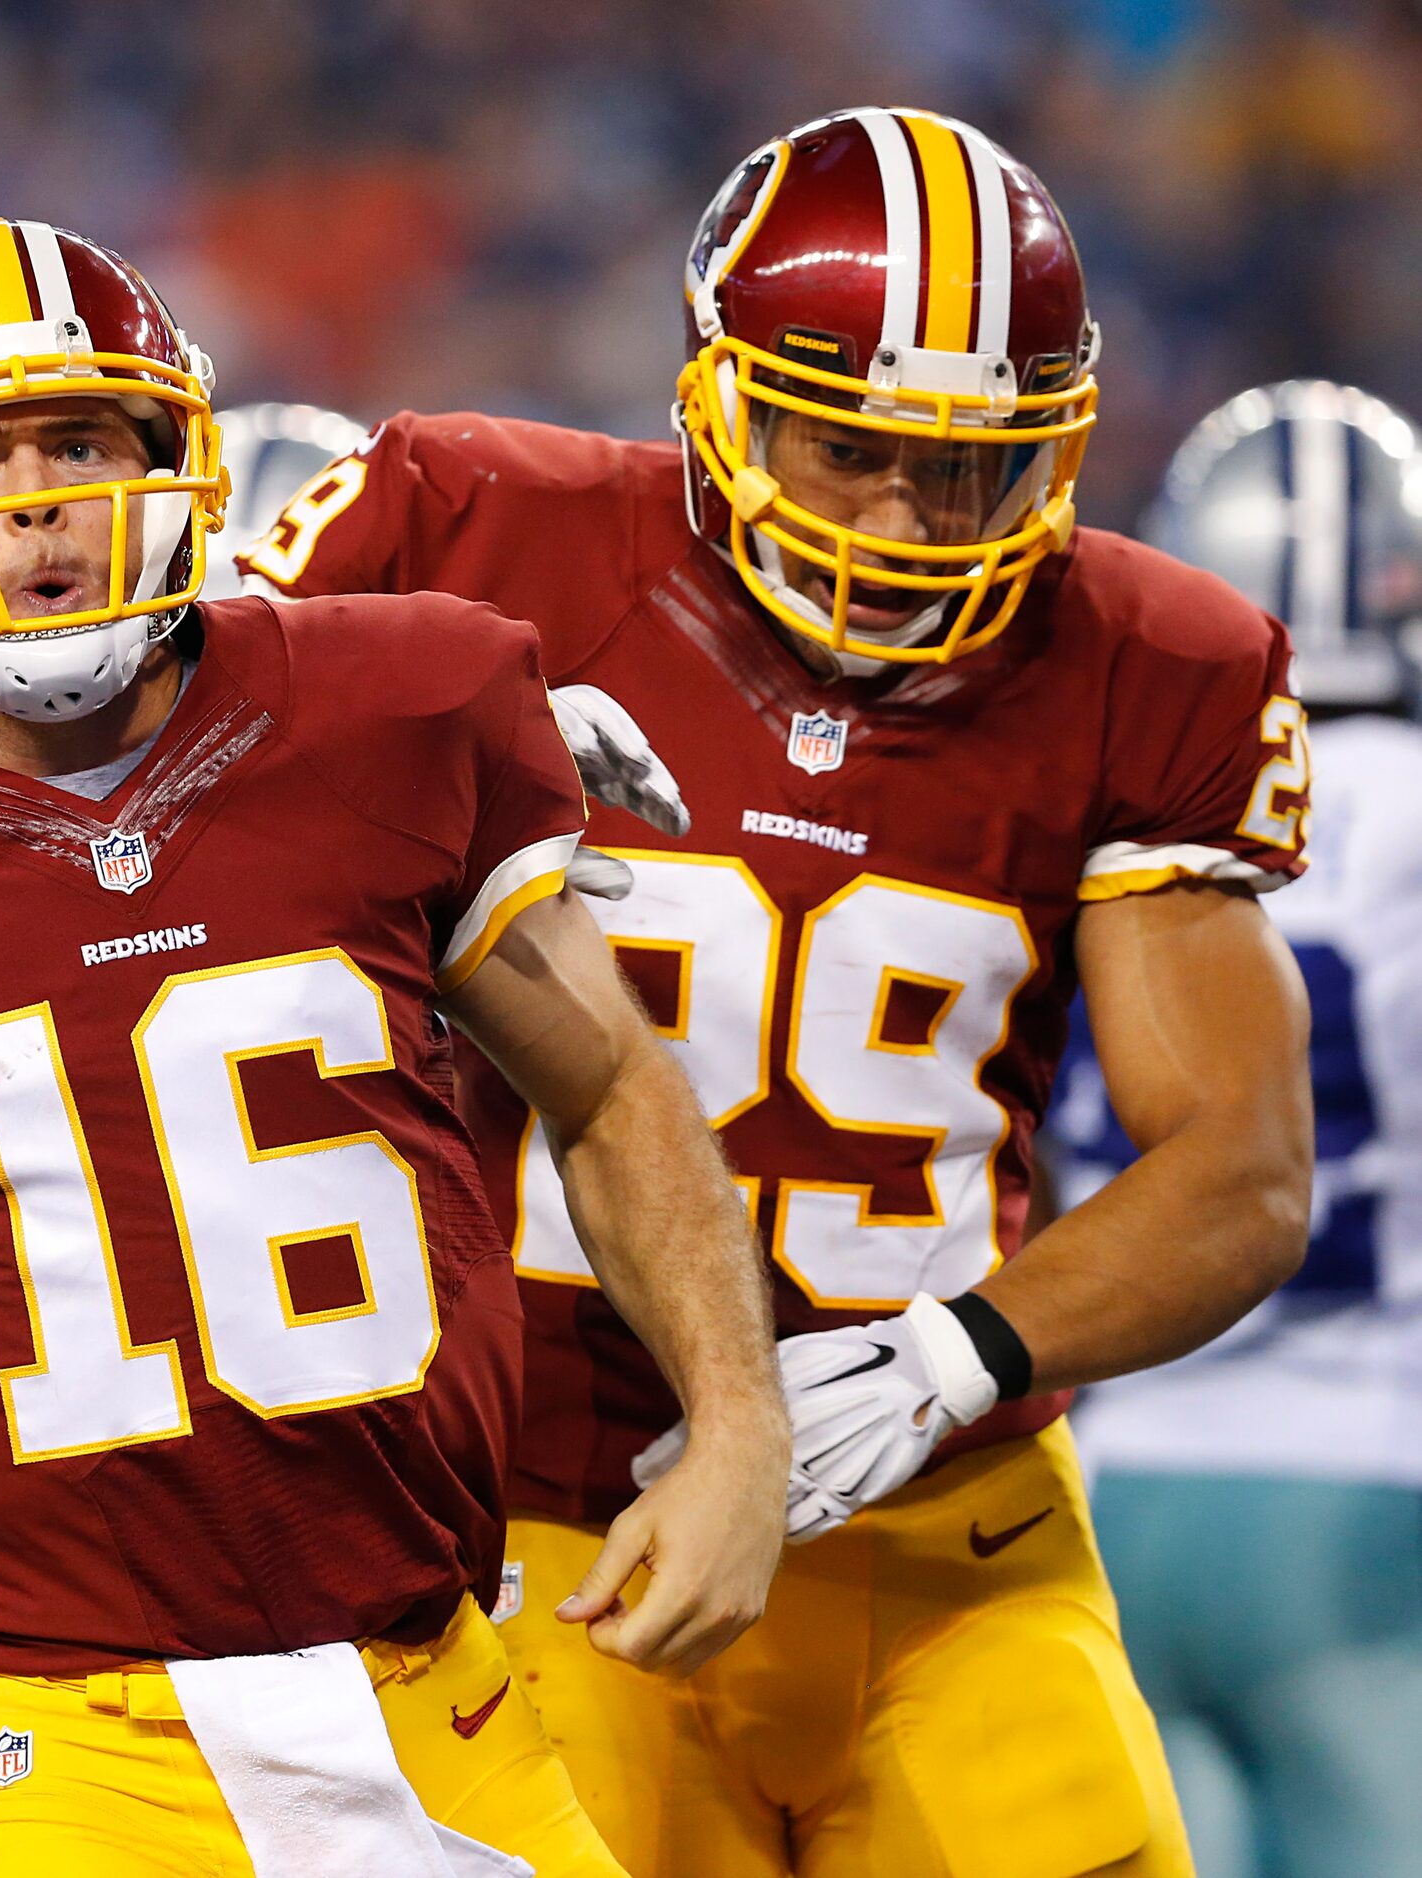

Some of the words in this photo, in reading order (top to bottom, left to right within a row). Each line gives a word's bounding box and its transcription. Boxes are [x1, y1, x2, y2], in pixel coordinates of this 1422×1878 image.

[784, 333, 839, 354] REDSKINS
[235, 456, 369, 585] 9
[796, 736, 835, 763] NFL
[741, 809, 869, 856] REDSKINS
[103, 856, 144, 883] NFL
[80, 923, 208, 967] REDSKINS
